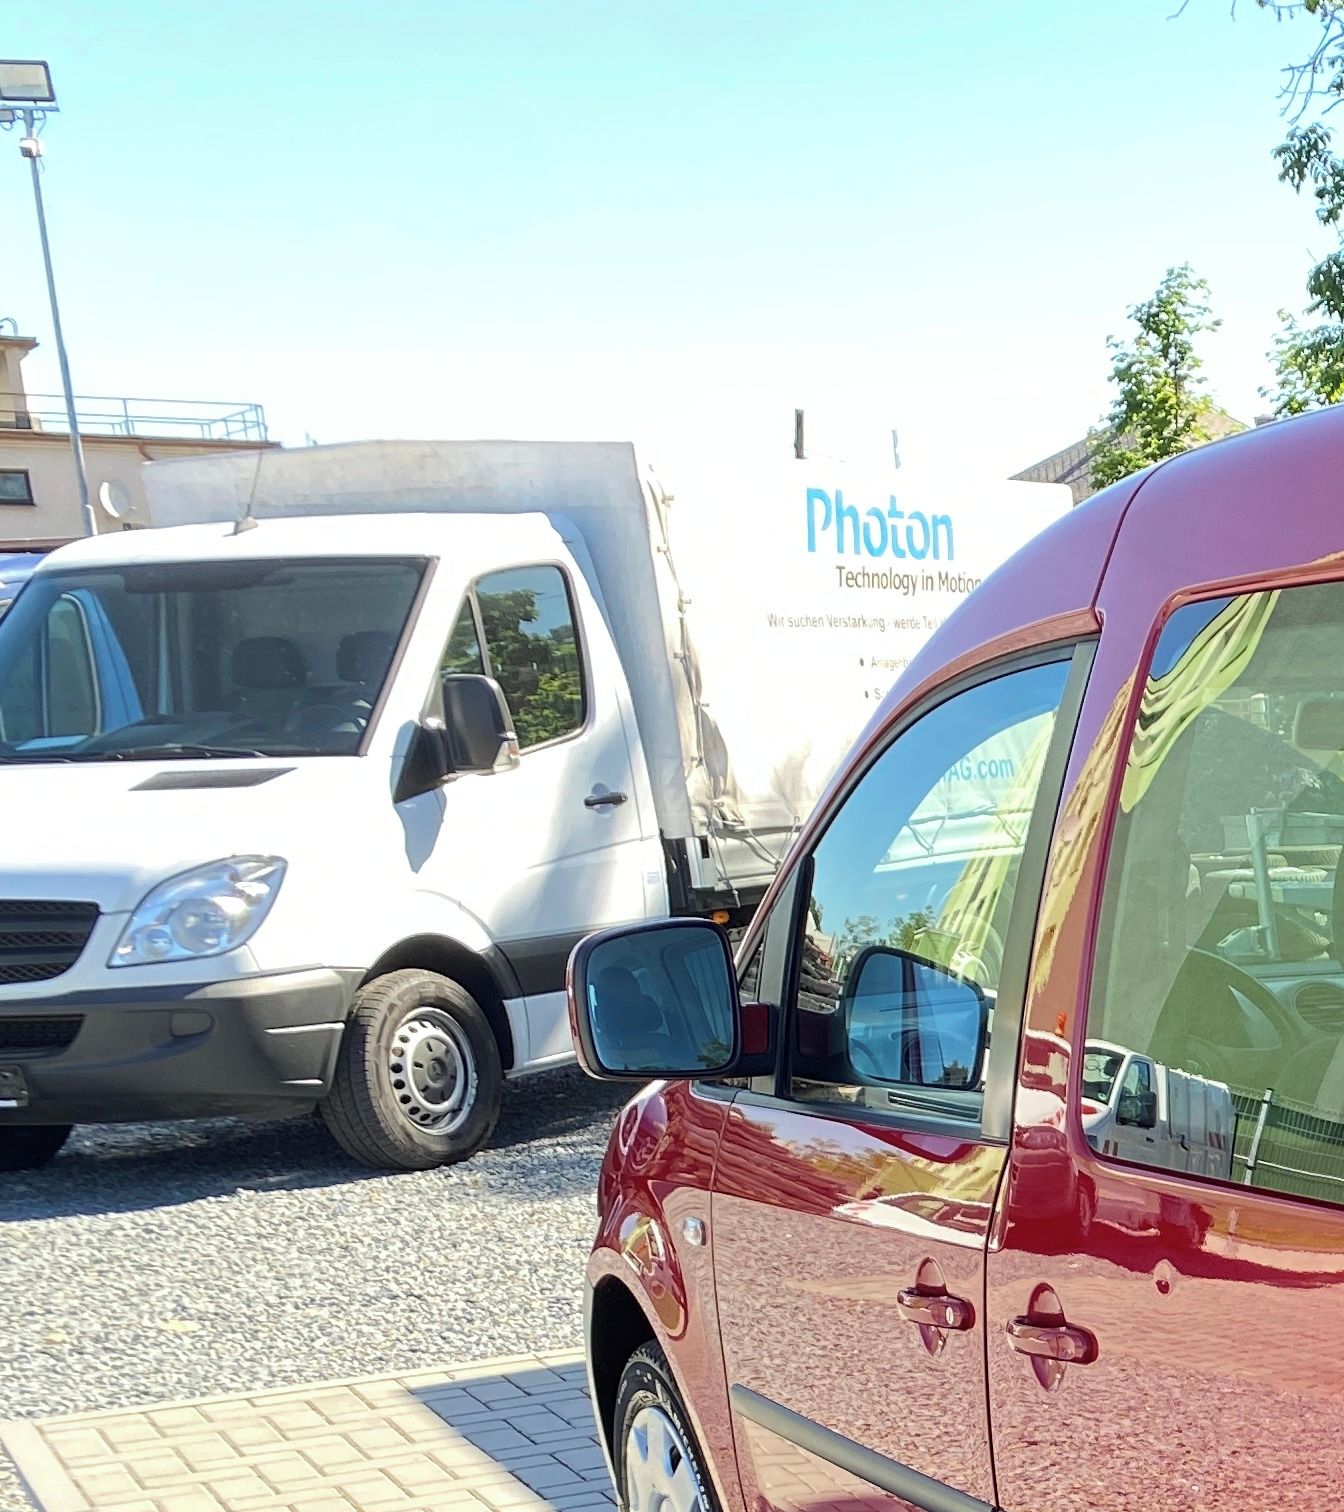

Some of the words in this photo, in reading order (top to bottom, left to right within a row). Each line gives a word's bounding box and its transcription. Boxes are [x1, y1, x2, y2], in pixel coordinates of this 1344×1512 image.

[806, 487, 955, 561] Photon
[835, 565, 918, 596] Technology
[922, 569, 934, 591] in
[788, 613, 825, 629] suchen
